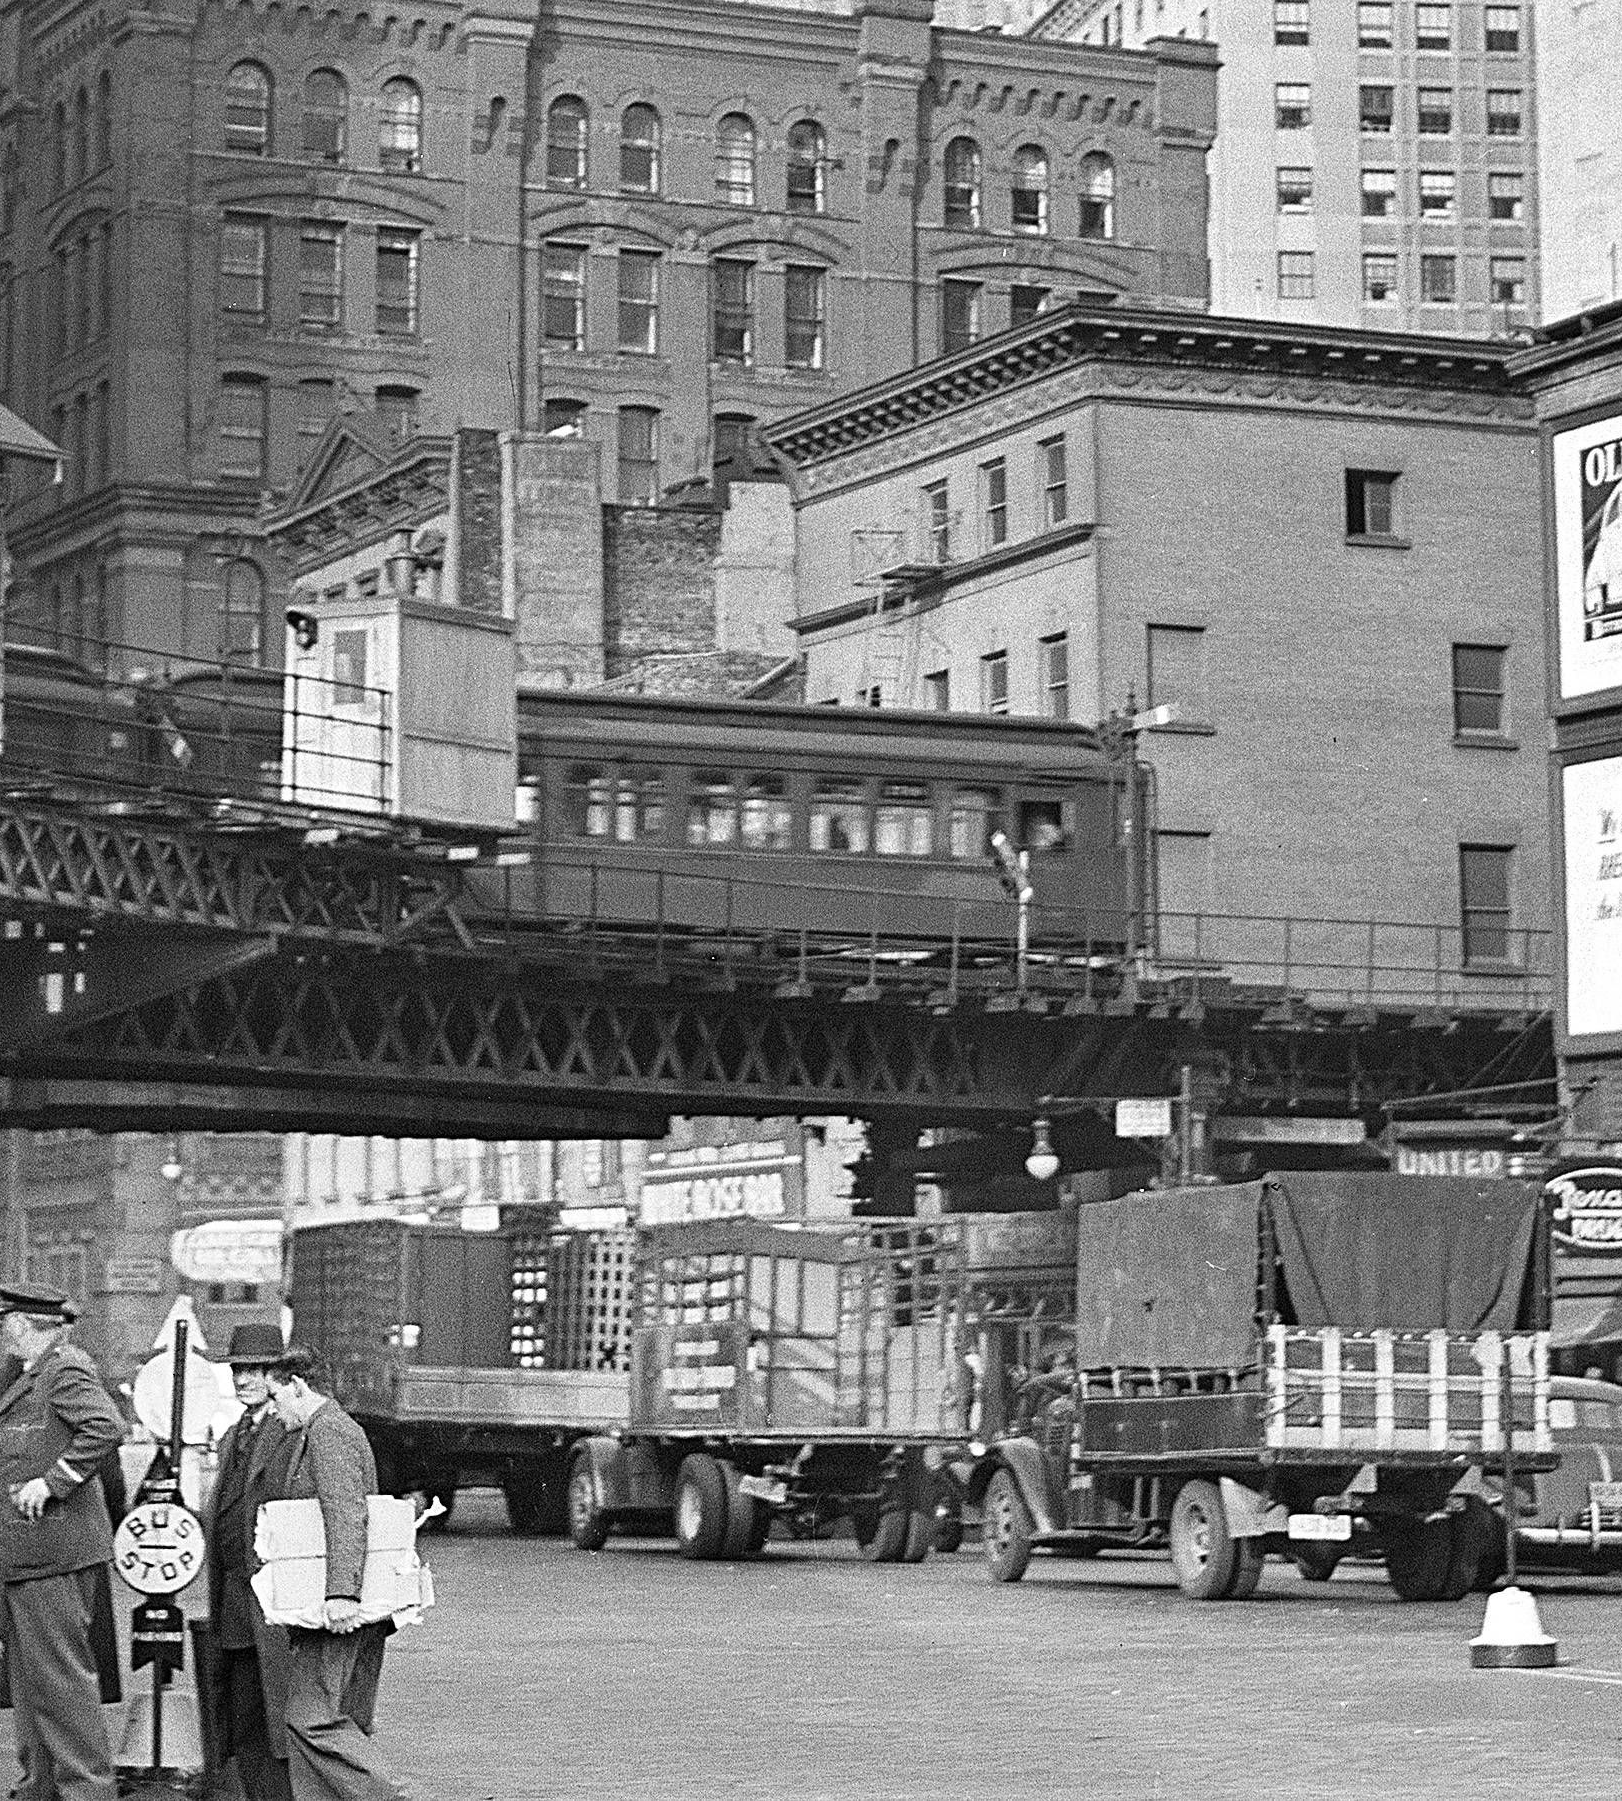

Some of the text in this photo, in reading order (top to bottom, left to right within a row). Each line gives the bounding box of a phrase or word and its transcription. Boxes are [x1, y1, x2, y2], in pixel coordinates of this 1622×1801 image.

[1397, 1149, 1502, 1176] UNITED
[124, 1507, 195, 1541] BUS
[120, 1550, 198, 1583] STOP
